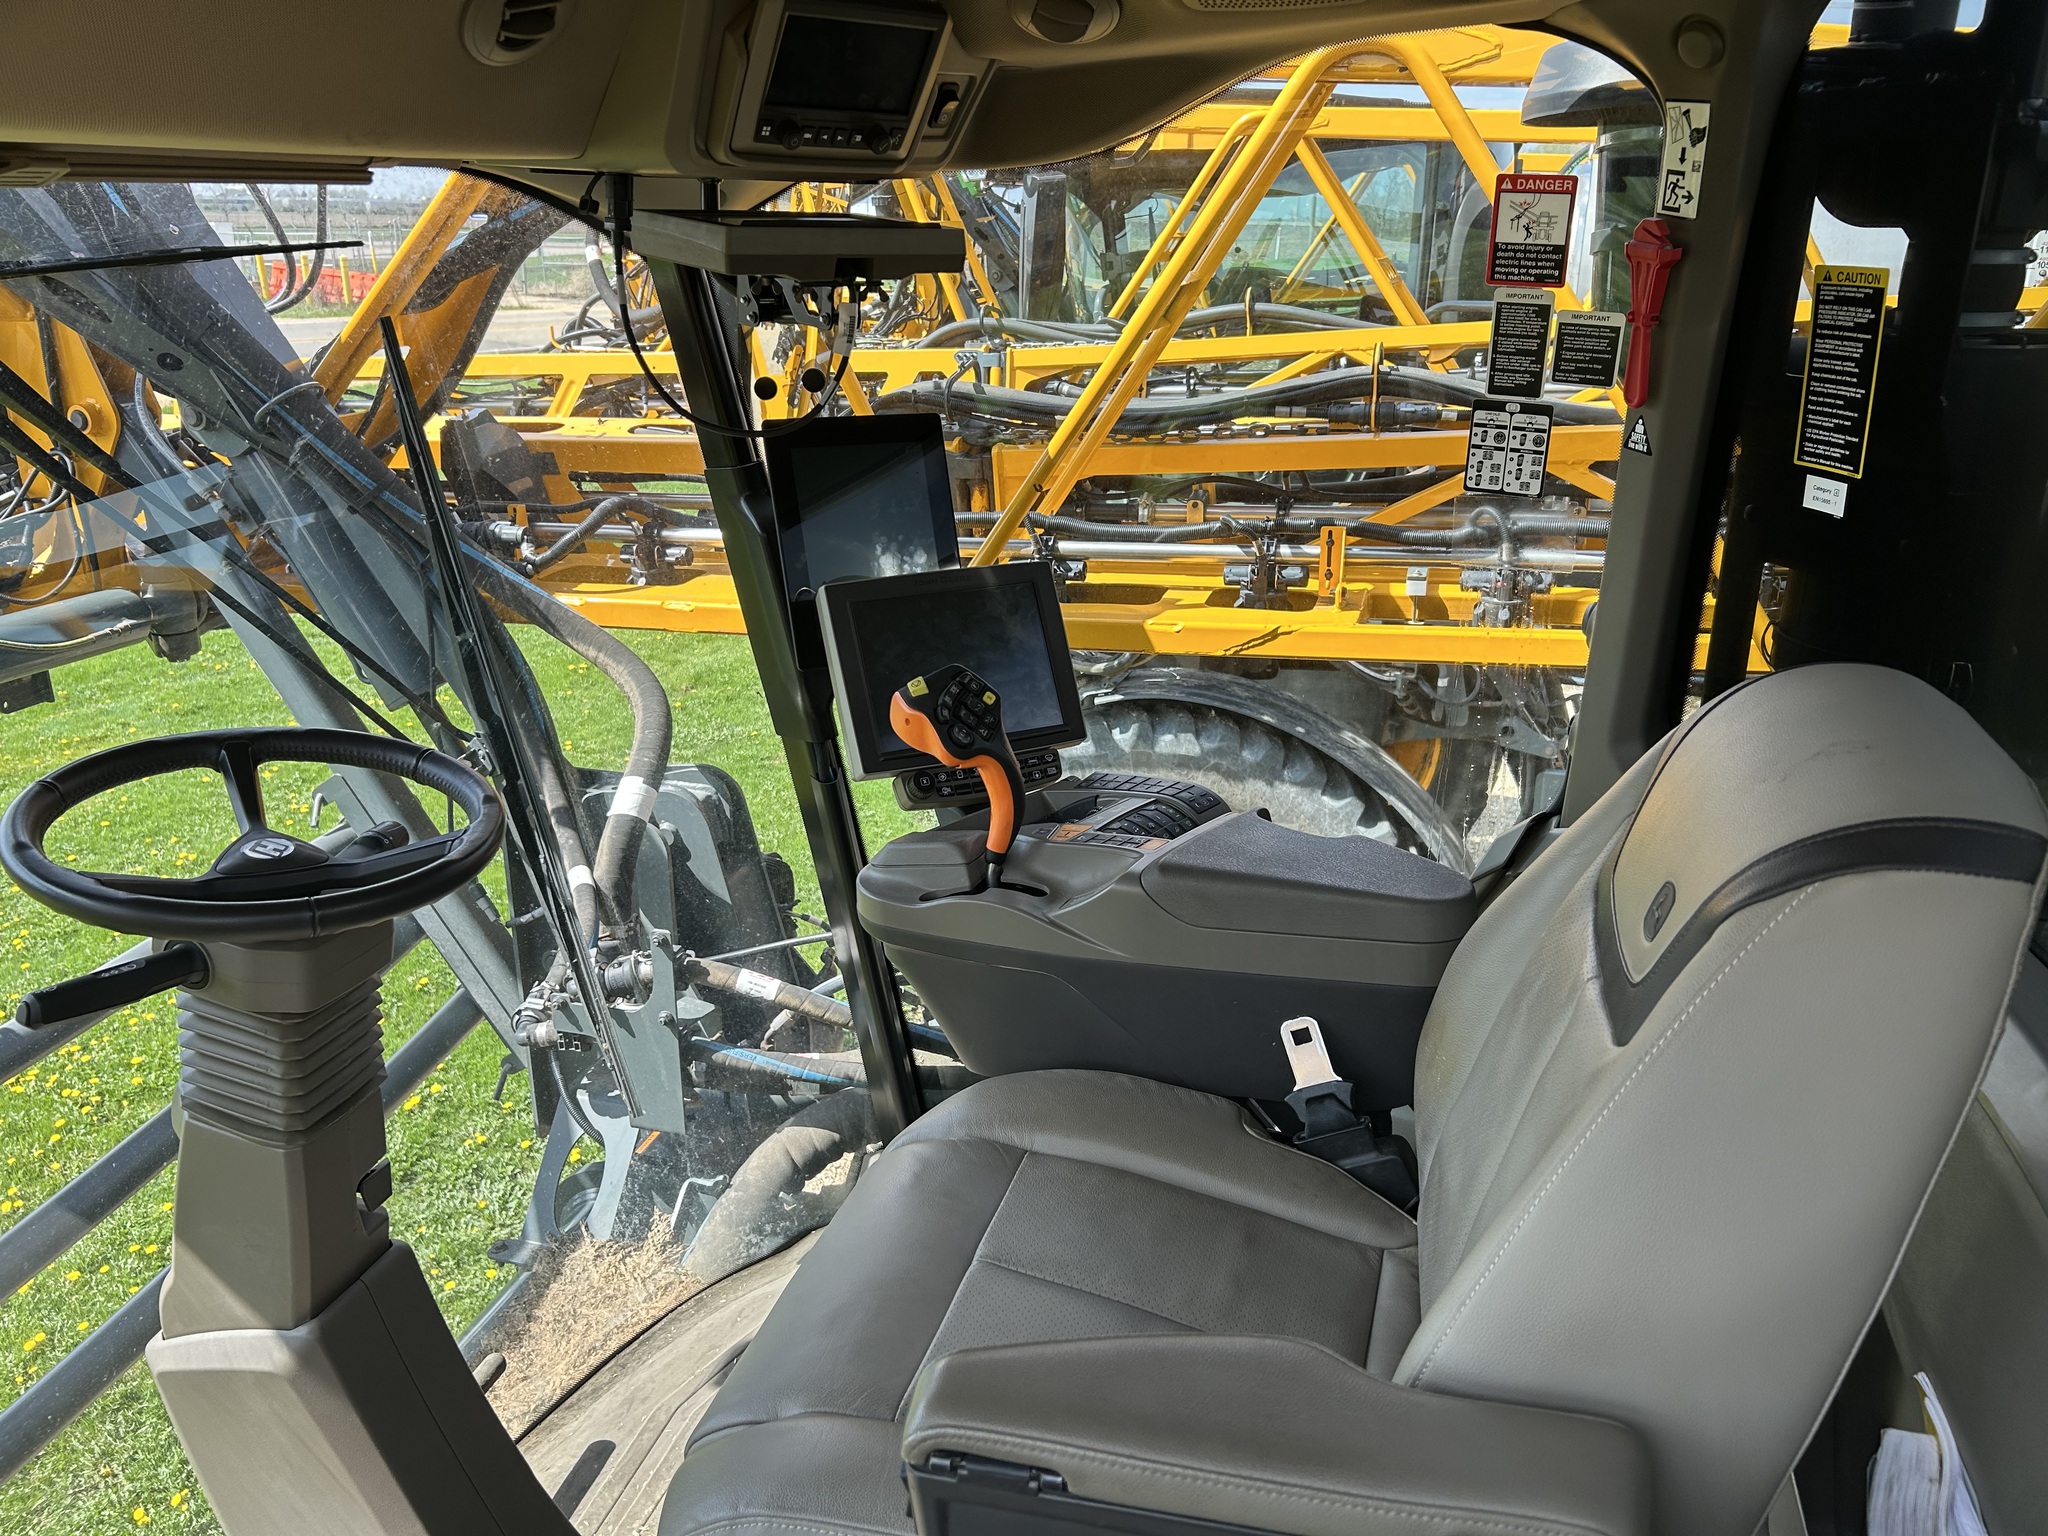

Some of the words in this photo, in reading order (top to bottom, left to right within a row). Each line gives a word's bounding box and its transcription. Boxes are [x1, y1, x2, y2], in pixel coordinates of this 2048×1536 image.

[1517, 179, 1572, 190] DANGER
[1495, 266, 1519, 274] moving
[1528, 268, 1559, 276] operating
[1837, 272, 1881, 284] CAUTION
[1812, 484, 1832, 494] Category
